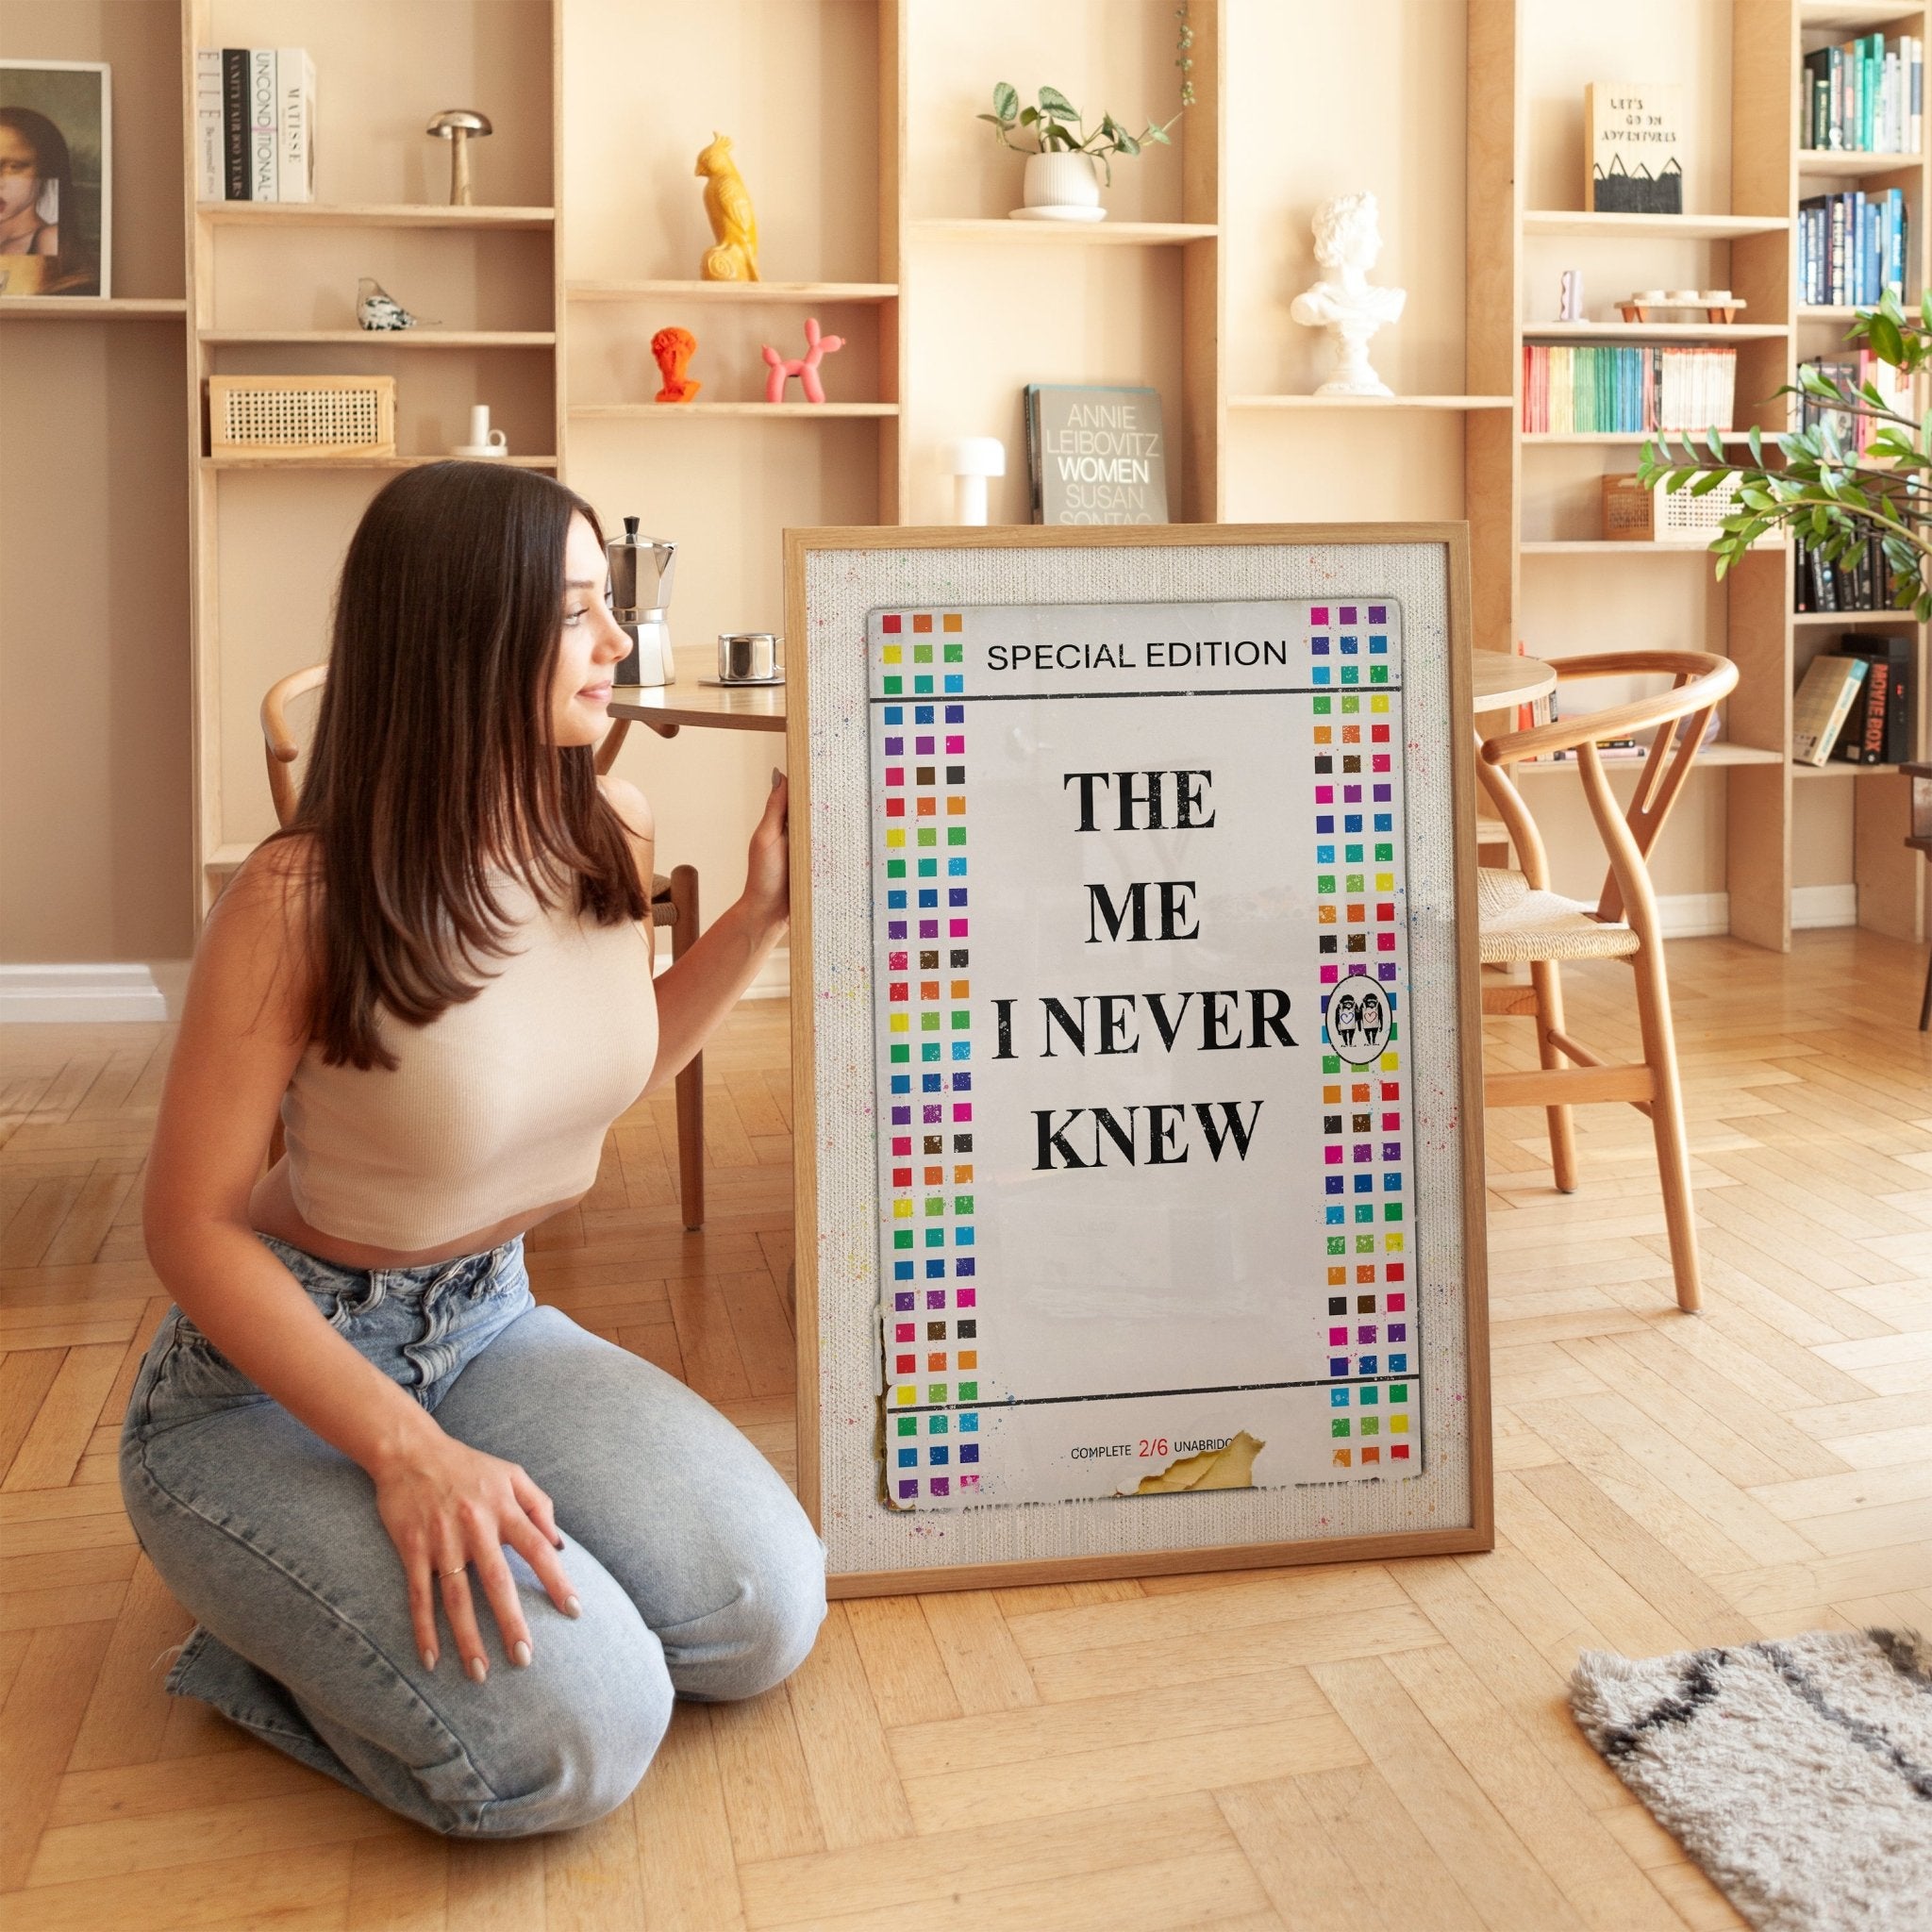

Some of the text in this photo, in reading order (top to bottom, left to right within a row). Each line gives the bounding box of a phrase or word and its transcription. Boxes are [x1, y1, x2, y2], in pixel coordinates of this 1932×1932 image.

[198, 52, 221, 118] ELLE
[230, 55, 241, 98] VANITY
[230, 103, 242, 132] FAIR
[1610, 98, 1643, 110] LET'S
[1625, 114, 1662, 125] GO ON
[256, 52, 272, 192] UNCONDITIONAL
[288, 88, 301, 163] MATISSE
[1602, 130, 1676, 142] ADVENTURES
[231, 157, 243, 197] YEARS
[1067, 403, 1137, 430] ANNIE
[1046, 429, 1160, 457] LEIBOVITZ
[1057, 457, 1150, 484] WOMEN
[1066, 484, 1144, 509] SUSAN
[987, 640, 1288, 671] SPECIAL EDITION
[1865, 664, 1889, 752] MOVIE BOX
[1063, 770, 1216, 832] THE
[1083, 881, 1200, 943] ME
[991, 989, 1300, 1059] I NEVER
[1030, 1100, 1265, 1171] KNEW
[1071, 1444, 1132, 1459] COMPLETE
[1139, 1438, 1169, 1457] 2/6
